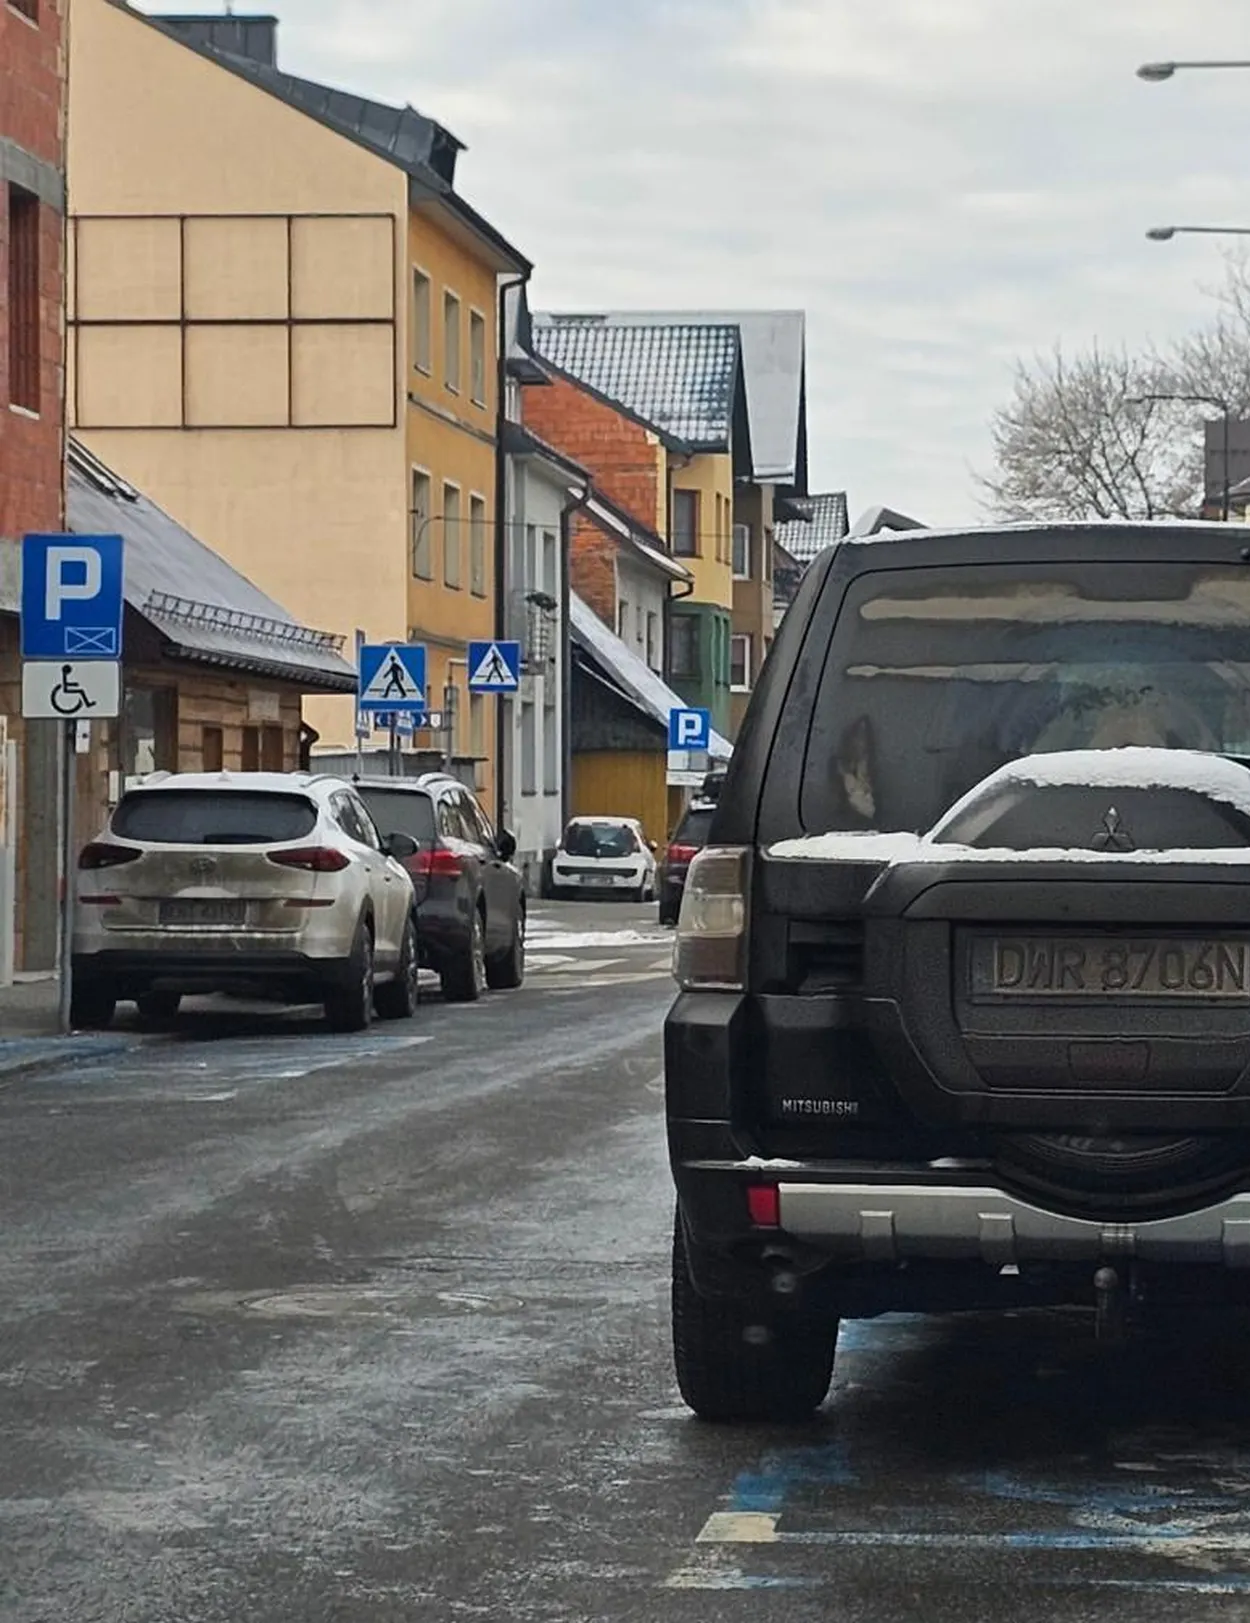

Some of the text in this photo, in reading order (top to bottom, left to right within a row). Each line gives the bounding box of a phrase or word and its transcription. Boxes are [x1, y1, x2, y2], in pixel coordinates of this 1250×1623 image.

[45, 546, 102, 621] P
[678, 712, 703, 746] P
[995, 942, 1248, 991] DWR 8706N
[782, 1099, 859, 1115] MITSUBISHI
